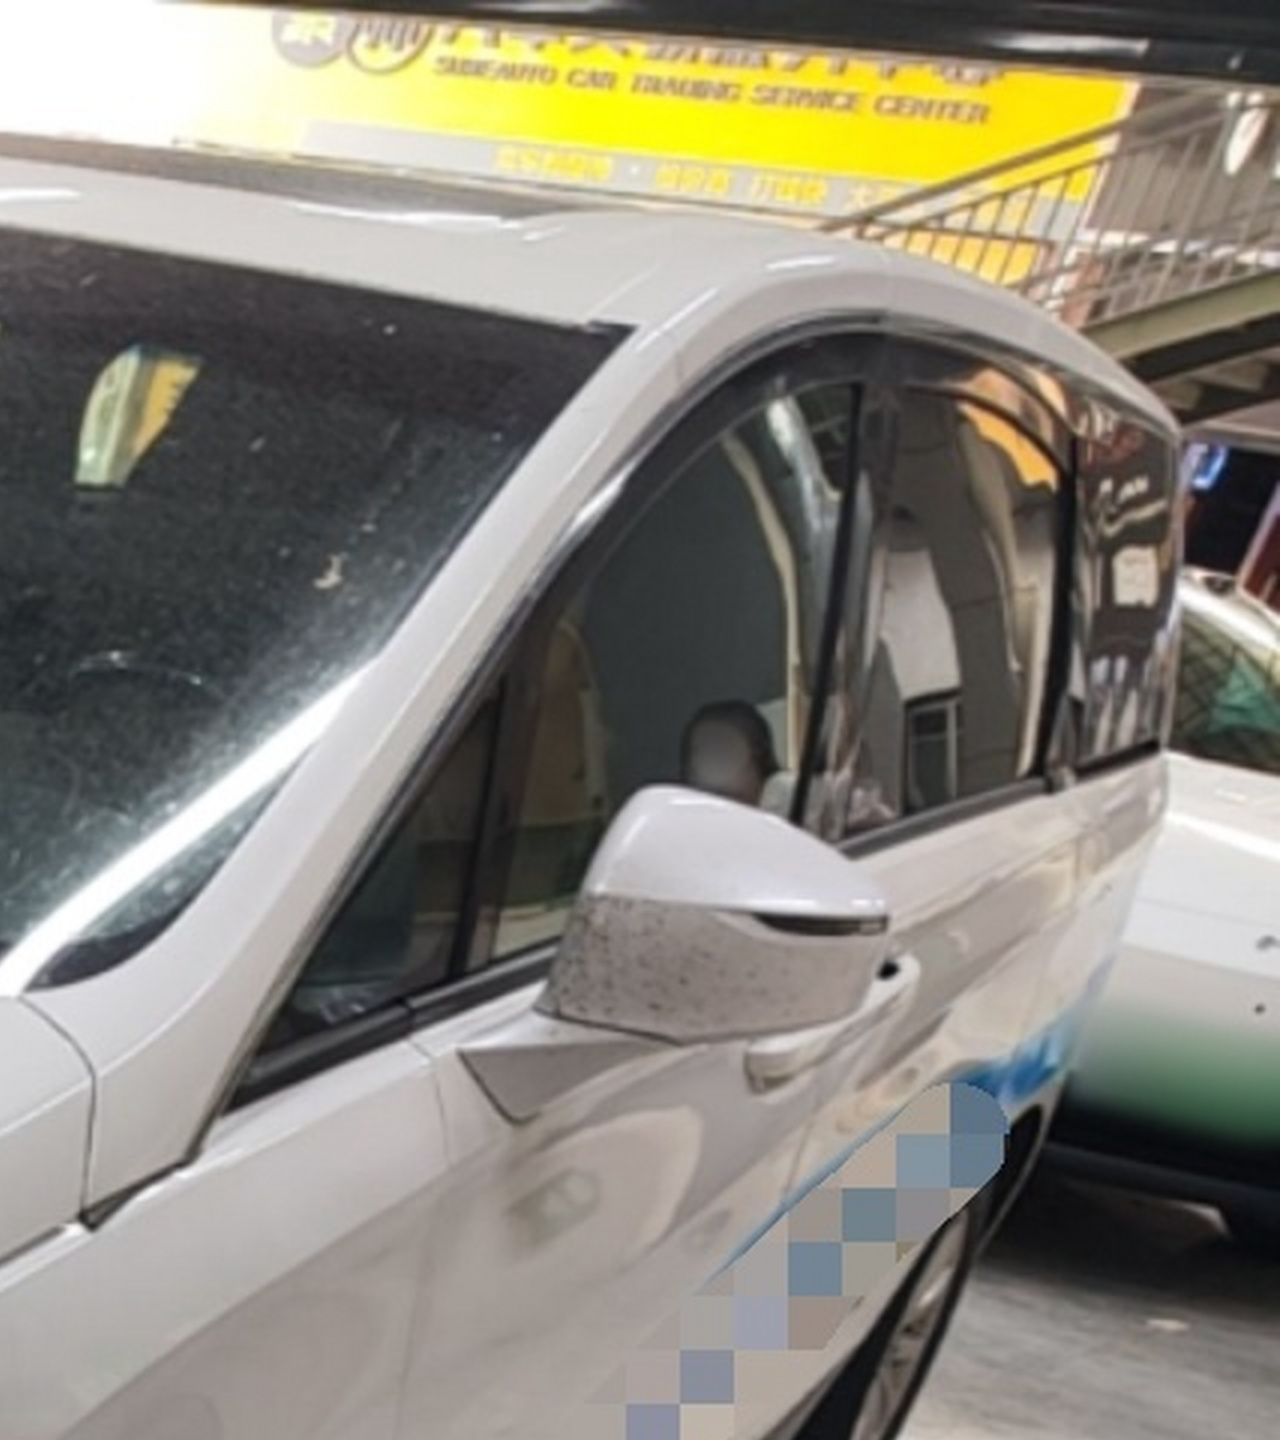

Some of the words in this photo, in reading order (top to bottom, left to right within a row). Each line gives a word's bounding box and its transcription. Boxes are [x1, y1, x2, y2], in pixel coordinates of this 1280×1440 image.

[565, 67, 618, 91] CAR
[628, 72, 743, 101] TRADING
[751, 83, 862, 113] SERVICE
[873, 94, 992, 124] CENTER
